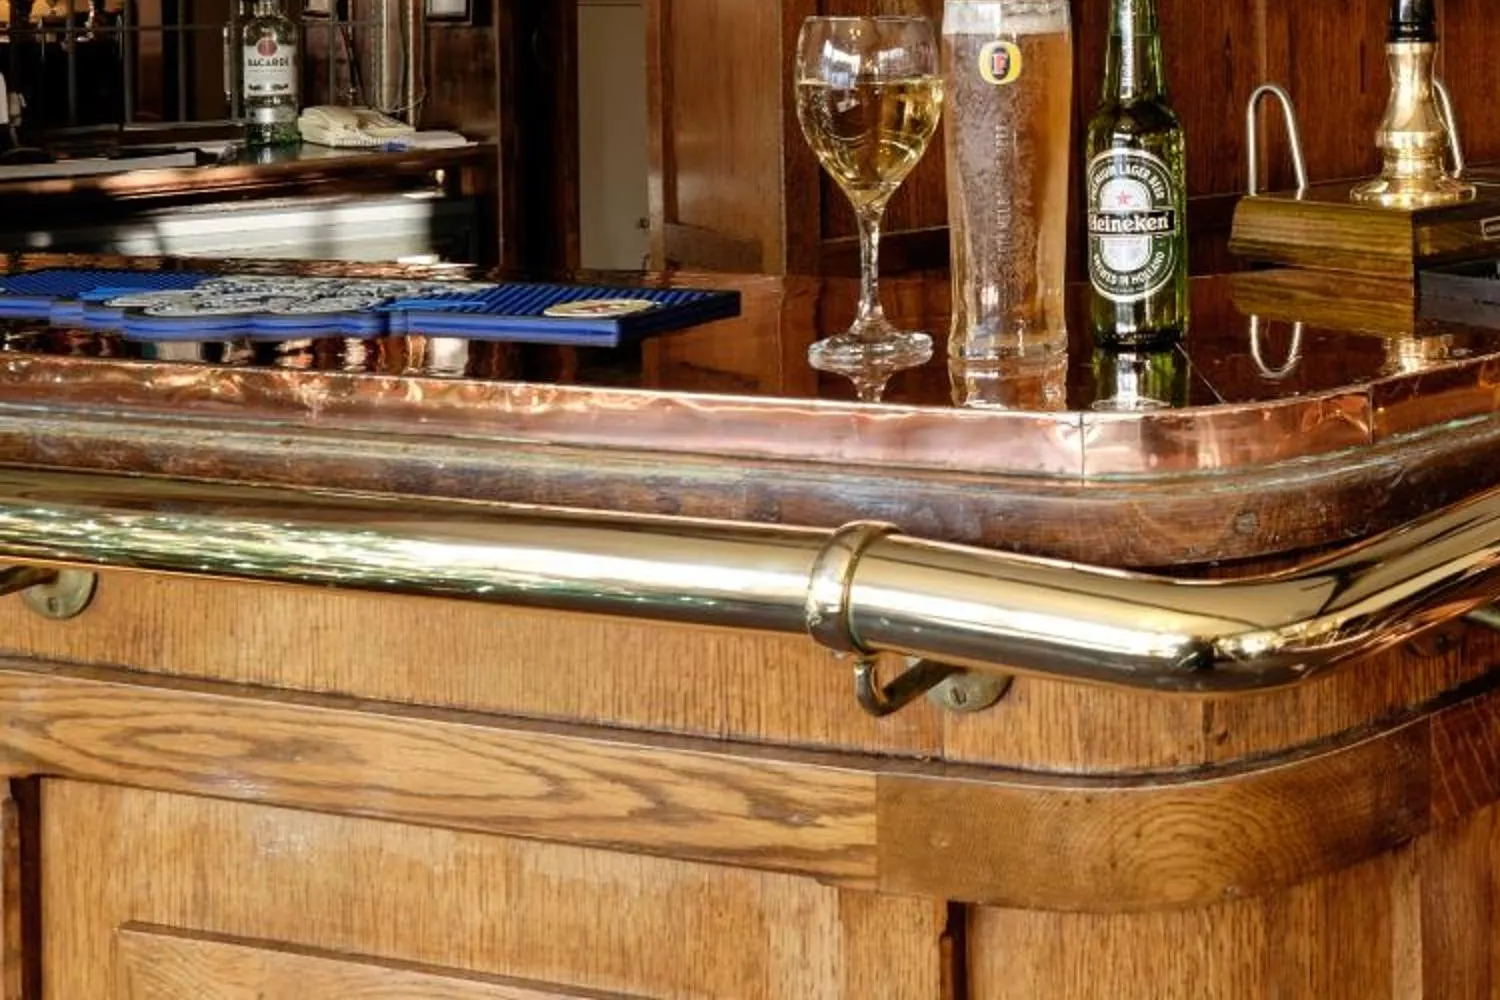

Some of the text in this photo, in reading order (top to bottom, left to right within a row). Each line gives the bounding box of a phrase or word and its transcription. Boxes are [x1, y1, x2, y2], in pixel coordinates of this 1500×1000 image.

[247, 57, 289, 67] BACARDI
[1119, 163, 1151, 179] LAGER
[1089, 213, 1169, 233] Heineken
